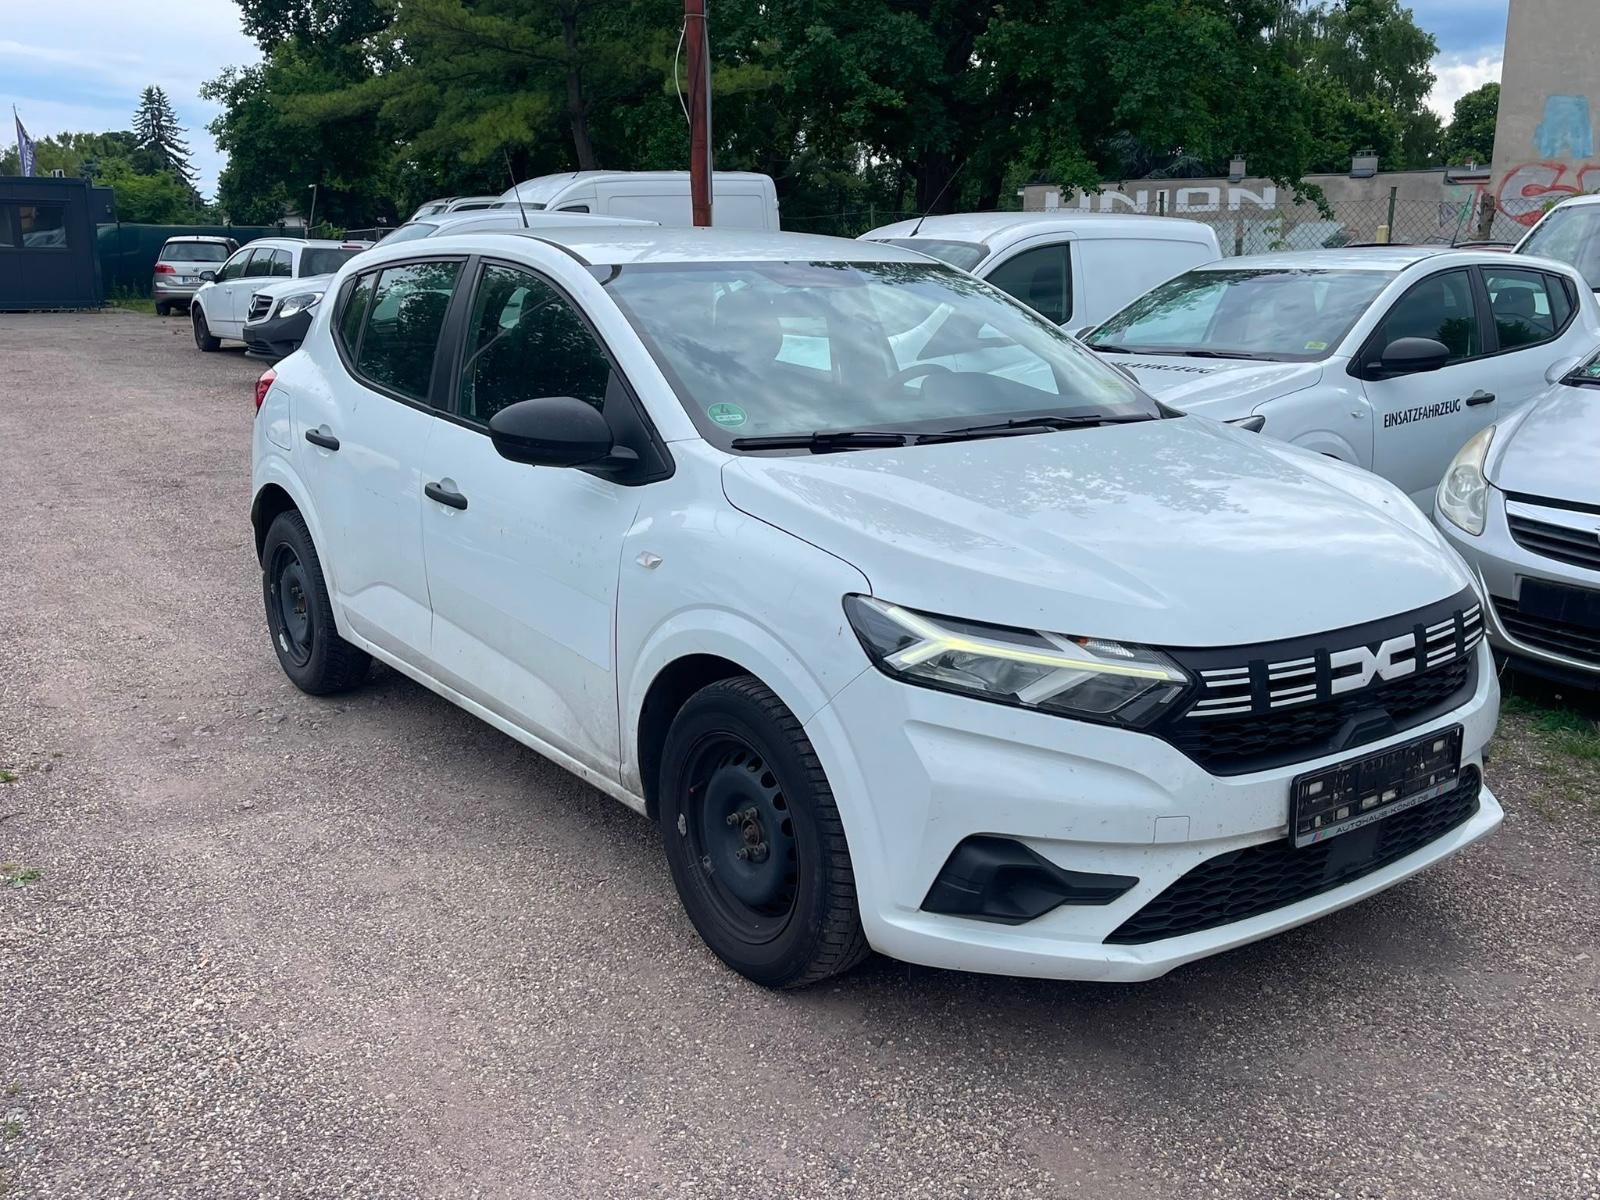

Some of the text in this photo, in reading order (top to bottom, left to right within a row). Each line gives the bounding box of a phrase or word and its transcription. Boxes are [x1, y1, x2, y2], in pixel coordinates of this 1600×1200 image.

[1045, 187, 1277, 213] UNION
[1116, 361, 1216, 374] FAHRZEUG
[1383, 399, 1461, 428] EINSATZFAHRZEUG
